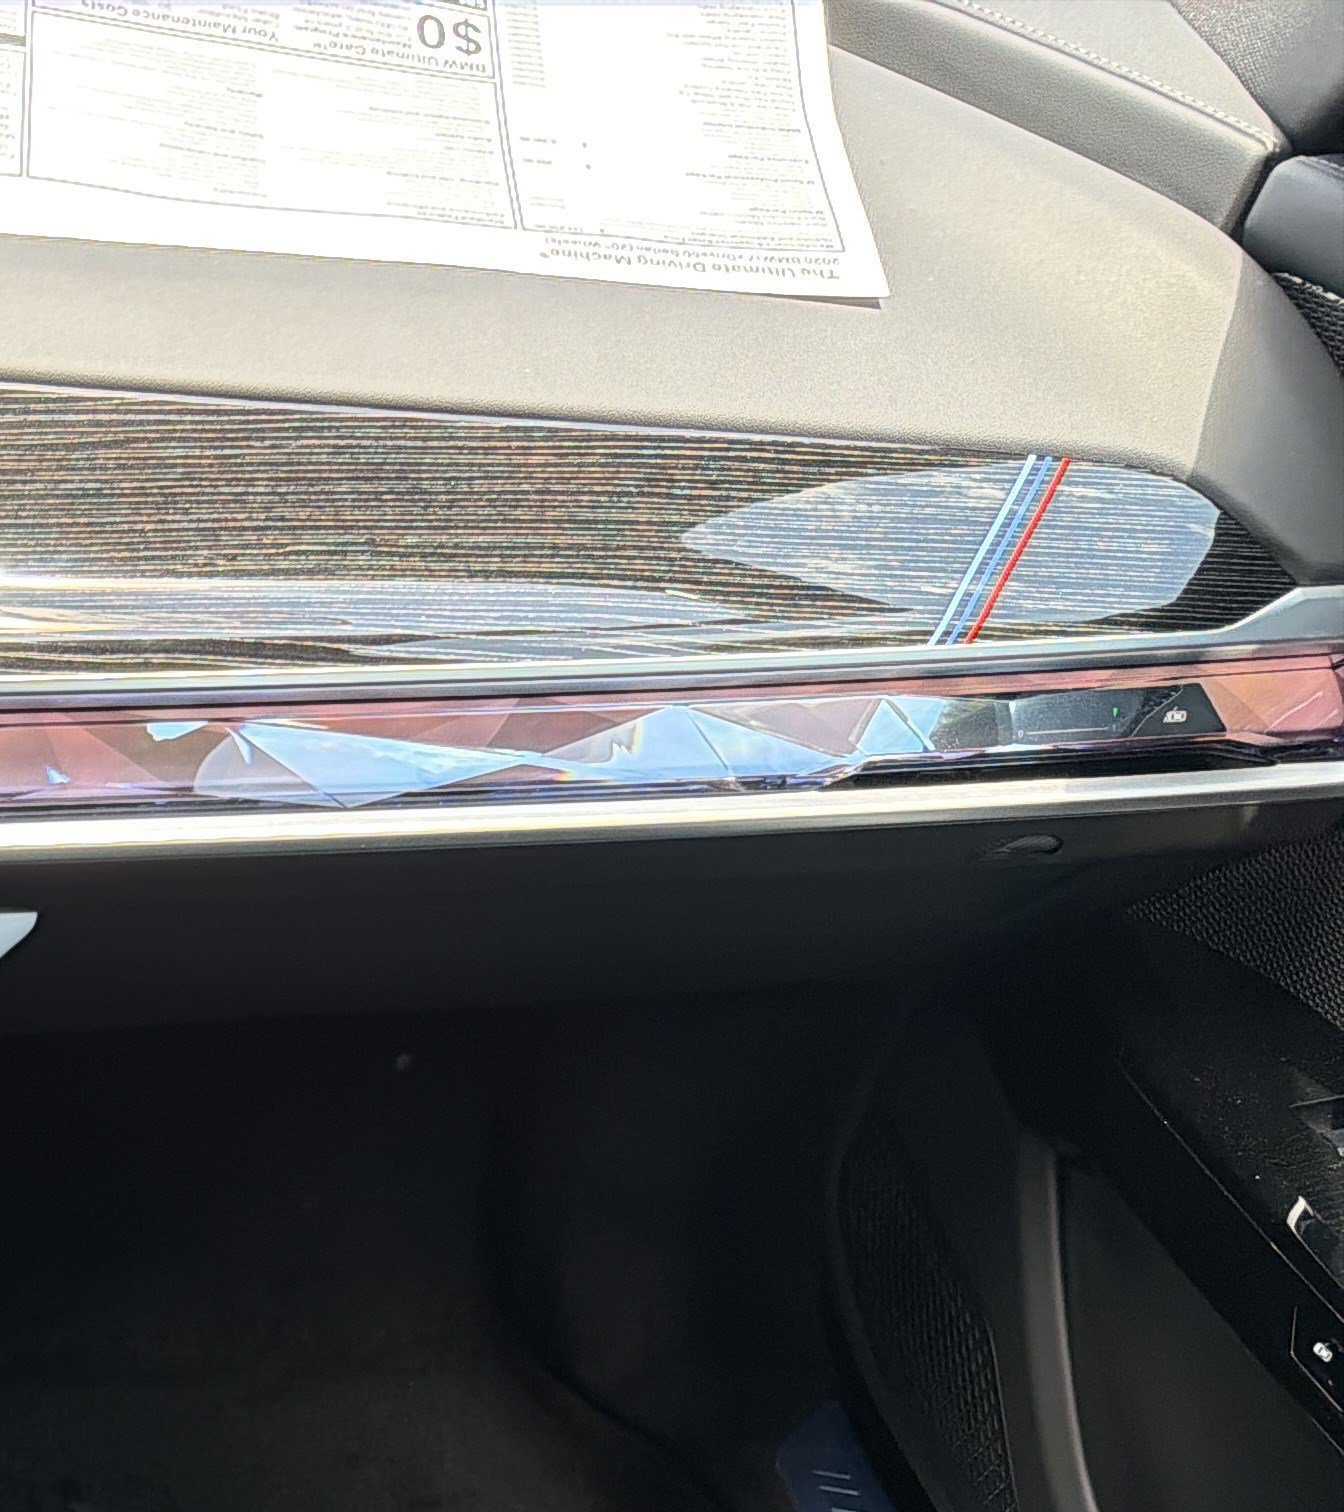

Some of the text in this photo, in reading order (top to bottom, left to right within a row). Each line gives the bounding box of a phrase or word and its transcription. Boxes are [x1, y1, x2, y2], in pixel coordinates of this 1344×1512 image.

[81, 0, 129, 17] Costs
[132, 9, 237, 35] Maintenance
[241, 26, 279, 43] Your
[416, 15, 483, 57] $0
[370, 47, 440, 68] Ultimate
[442, 60, 487, 74] BMW
[636, 254, 707, 274] Driving
[711, 262, 796, 279] Ultimate
[800, 267, 841, 280] The
